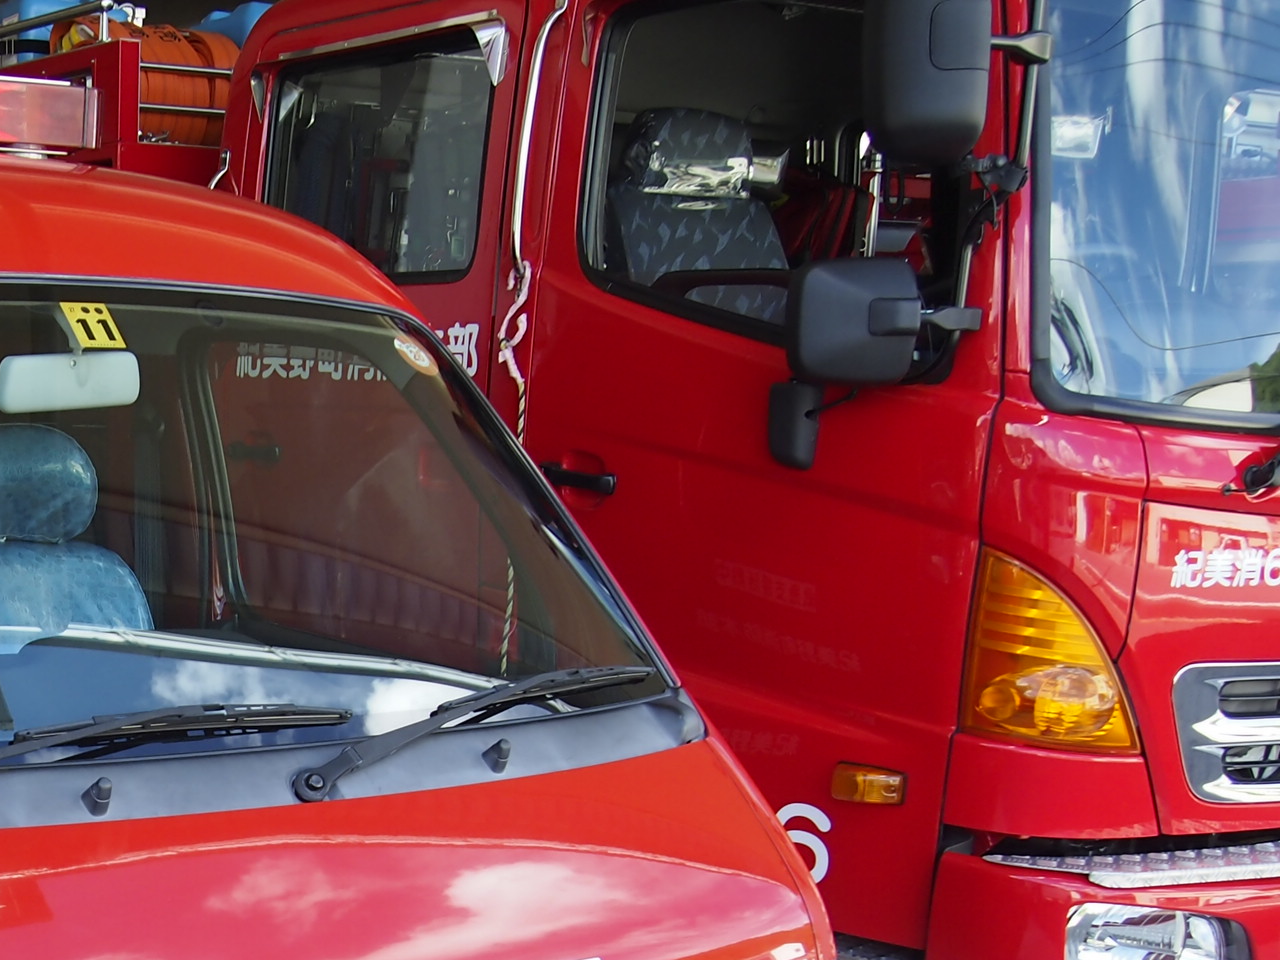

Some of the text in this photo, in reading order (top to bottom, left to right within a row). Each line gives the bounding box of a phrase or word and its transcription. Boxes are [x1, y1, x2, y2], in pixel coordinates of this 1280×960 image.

[75, 318, 118, 341] 11
[1169, 547, 1280, 588] 紀美消6
